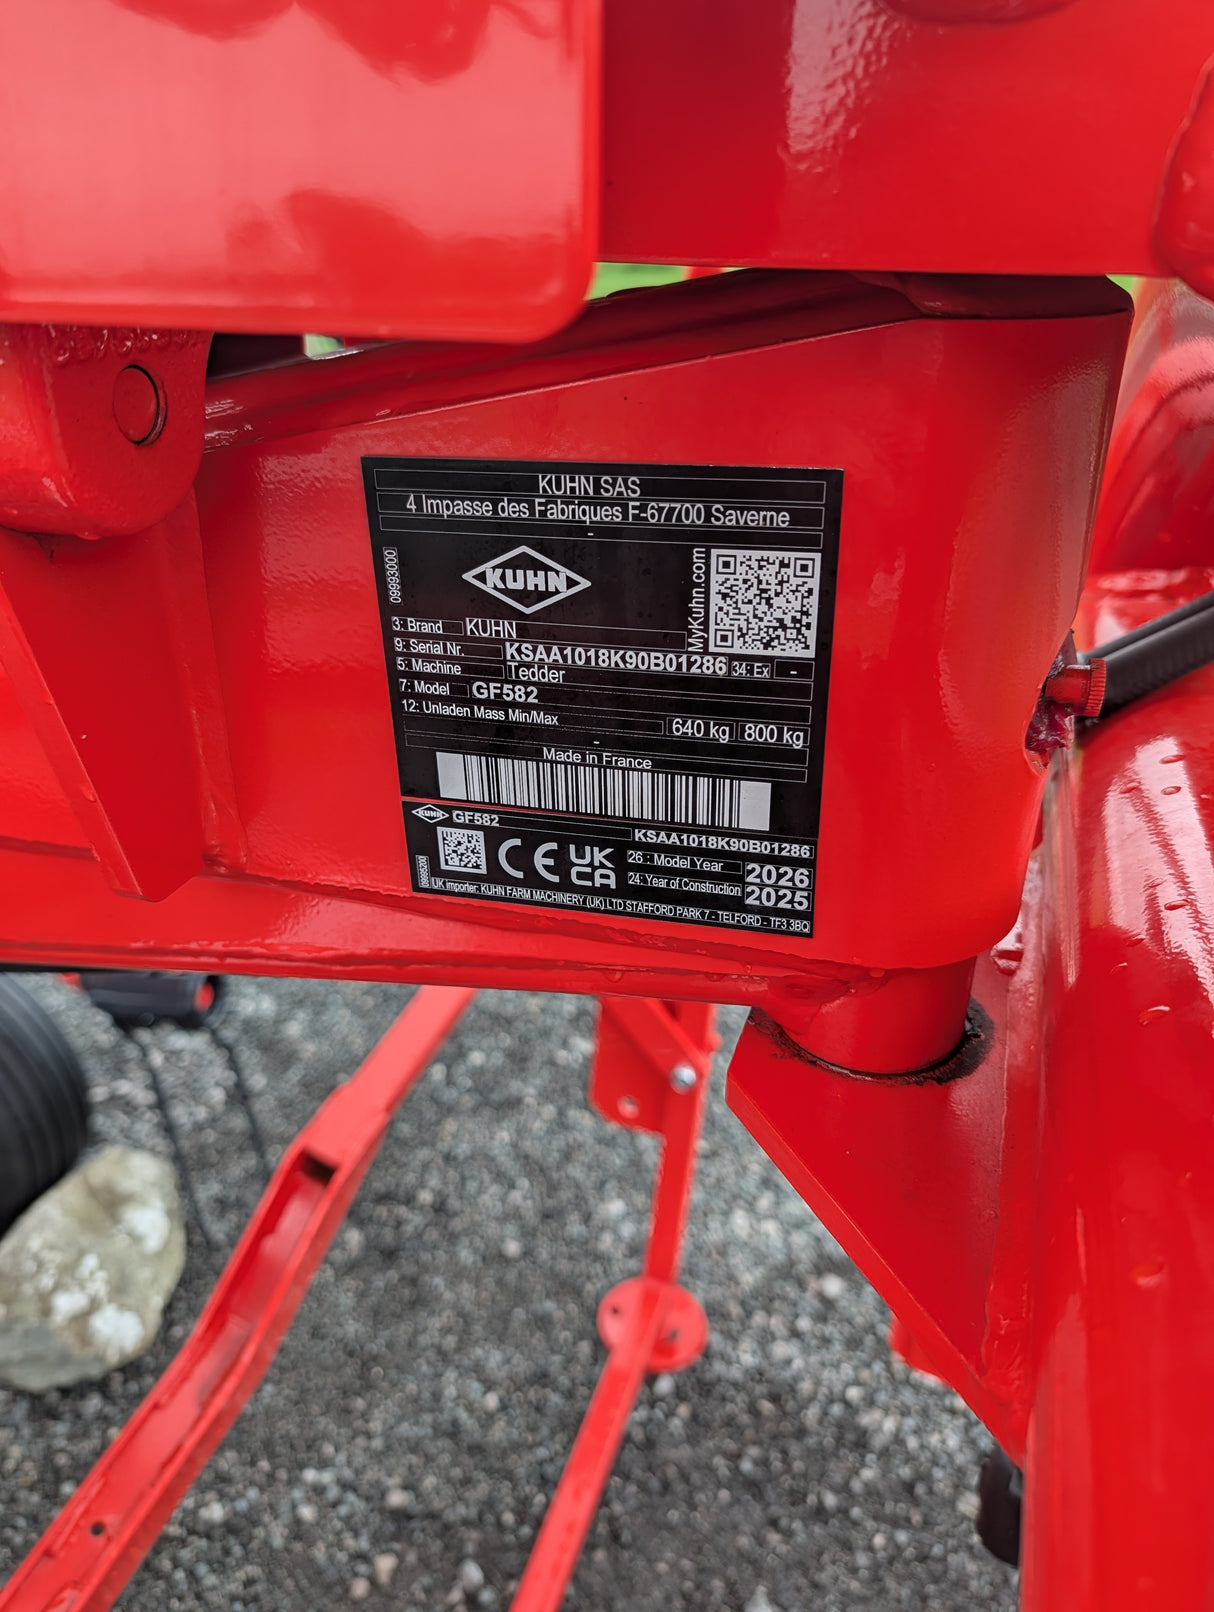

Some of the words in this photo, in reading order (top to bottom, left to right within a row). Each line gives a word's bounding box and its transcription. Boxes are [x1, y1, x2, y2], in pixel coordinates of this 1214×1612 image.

[538, 473, 594, 496] KUHN
[600, 476, 641, 497] SAS
[406, 494, 417, 513] 4
[422, 494, 493, 519] Impasse
[498, 497, 529, 518] des
[534, 498, 622, 525] Fabriques
[628, 502, 705, 524] F-67700
[710, 504, 791, 528] Saverne
[384, 549, 402, 604] 09993000
[484, 567, 568, 594] KUHN
[687, 547, 708, 652] MyKuhn.com
[392, 617, 404, 631] 3:
[407, 618, 443, 634] Brand
[465, 617, 517, 639] KUHN
[394, 638, 405, 652] 9:
[409, 639, 443, 655] Serial
[446, 641, 465, 656] Nr.
[505, 641, 728, 675] KSAA1018K90B01286
[397, 657, 408, 670] 5:
[412, 658, 462, 675] Machine
[507, 661, 566, 684] Tedder
[732, 661, 750, 677] 34:
[754, 663, 770, 677] Ex
[399, 679, 412, 692] 7:
[414, 680, 450, 696] Model
[471, 681, 539, 704] GF582
[402, 699, 419, 713] 12:
[422, 700, 471, 718] Unladen
[474, 705, 505, 721] Mass
[508, 709, 559, 725] Min/Max
[672, 717, 705, 737] 640
[709, 721, 730, 743] kg
[744, 723, 778, 743] 800
[783, 726, 804, 749] kg
[543, 746, 582, 763] Made
[586, 751, 598, 764] in
[602, 752, 652, 769] France
[452, 810, 500, 827] GF582
[634, 828, 811, 858] KSAA1018K90B01286
[569, 844, 616, 868] UK
[654, 853, 691, 869] Model
[694, 857, 724, 872] Year
[570, 866, 617, 889] CA
[628, 872, 644, 885] 24:
[647, 875, 667, 888] Year
[669, 877, 680, 888] of
[681, 879, 742, 896] Construction
[744, 863, 810, 888] 2026
[431, 877, 445, 889] UK
[480, 884, 505, 896] KUHN
[507, 886, 531, 899] FARM
[533, 889, 584, 906] MACHINERY
[586, 894, 605, 910] (UK)
[606, 897, 624, 911] LTD
[626, 900, 674, 917] STAFFORD
[676, 906, 702, 920] PARK
[704, 910, 710, 920] 7
[717, 911, 762, 927] TELFORD
[770, 917, 787, 930] TF3
[789, 919, 810, 933] 3BQ
[744, 885, 809, 910] 2025
